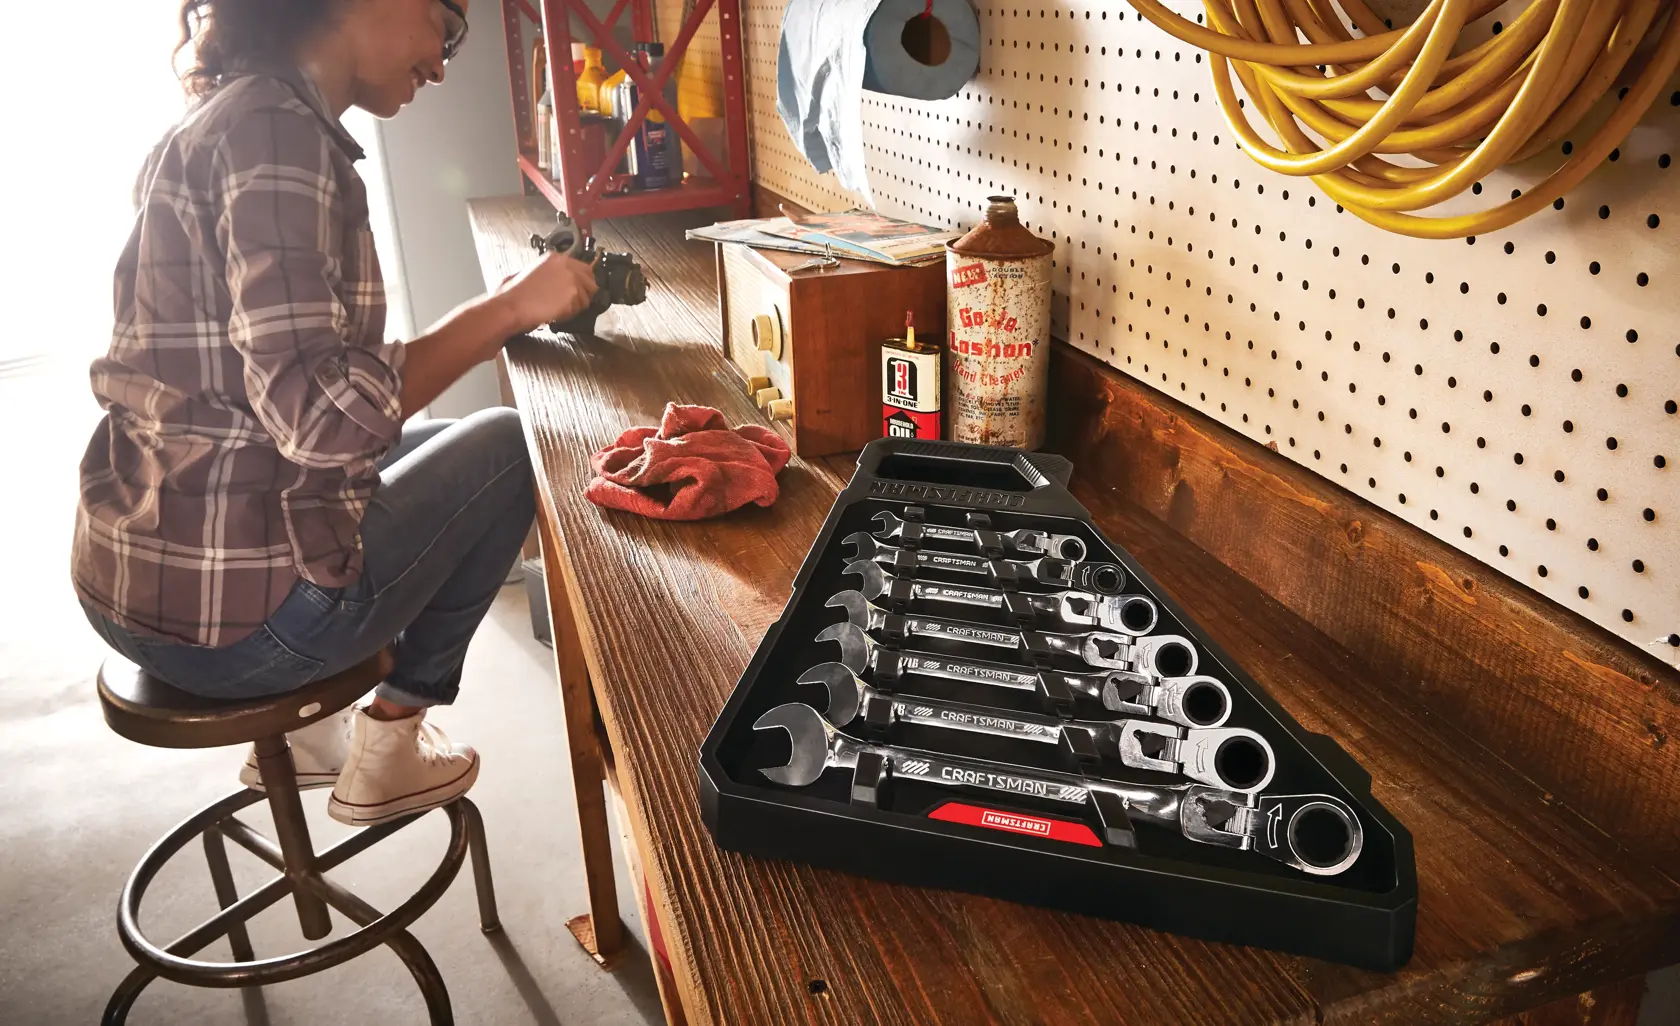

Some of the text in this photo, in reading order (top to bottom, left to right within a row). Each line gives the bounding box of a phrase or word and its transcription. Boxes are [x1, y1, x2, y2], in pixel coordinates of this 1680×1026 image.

[953, 359, 977, 383] Hand
[981, 367, 1025, 386] Cleaner
[869, 480, 1026, 507] CRAFTSMAN
[937, 528, 974, 537] CRAFTSMAN
[933, 556, 976, 567] CRAFTSMAN
[943, 589, 988, 600] CRAFTSMAN
[946, 626, 1004, 642] CRAFTSMAN
[946, 664, 1010, 682] CRAFTSMAN
[941, 710, 1015, 731] CRAFTSMAN
[941, 766, 1047, 795] CRAFTSMAN
[986, 814, 1047, 831] CRAFTSMAN
